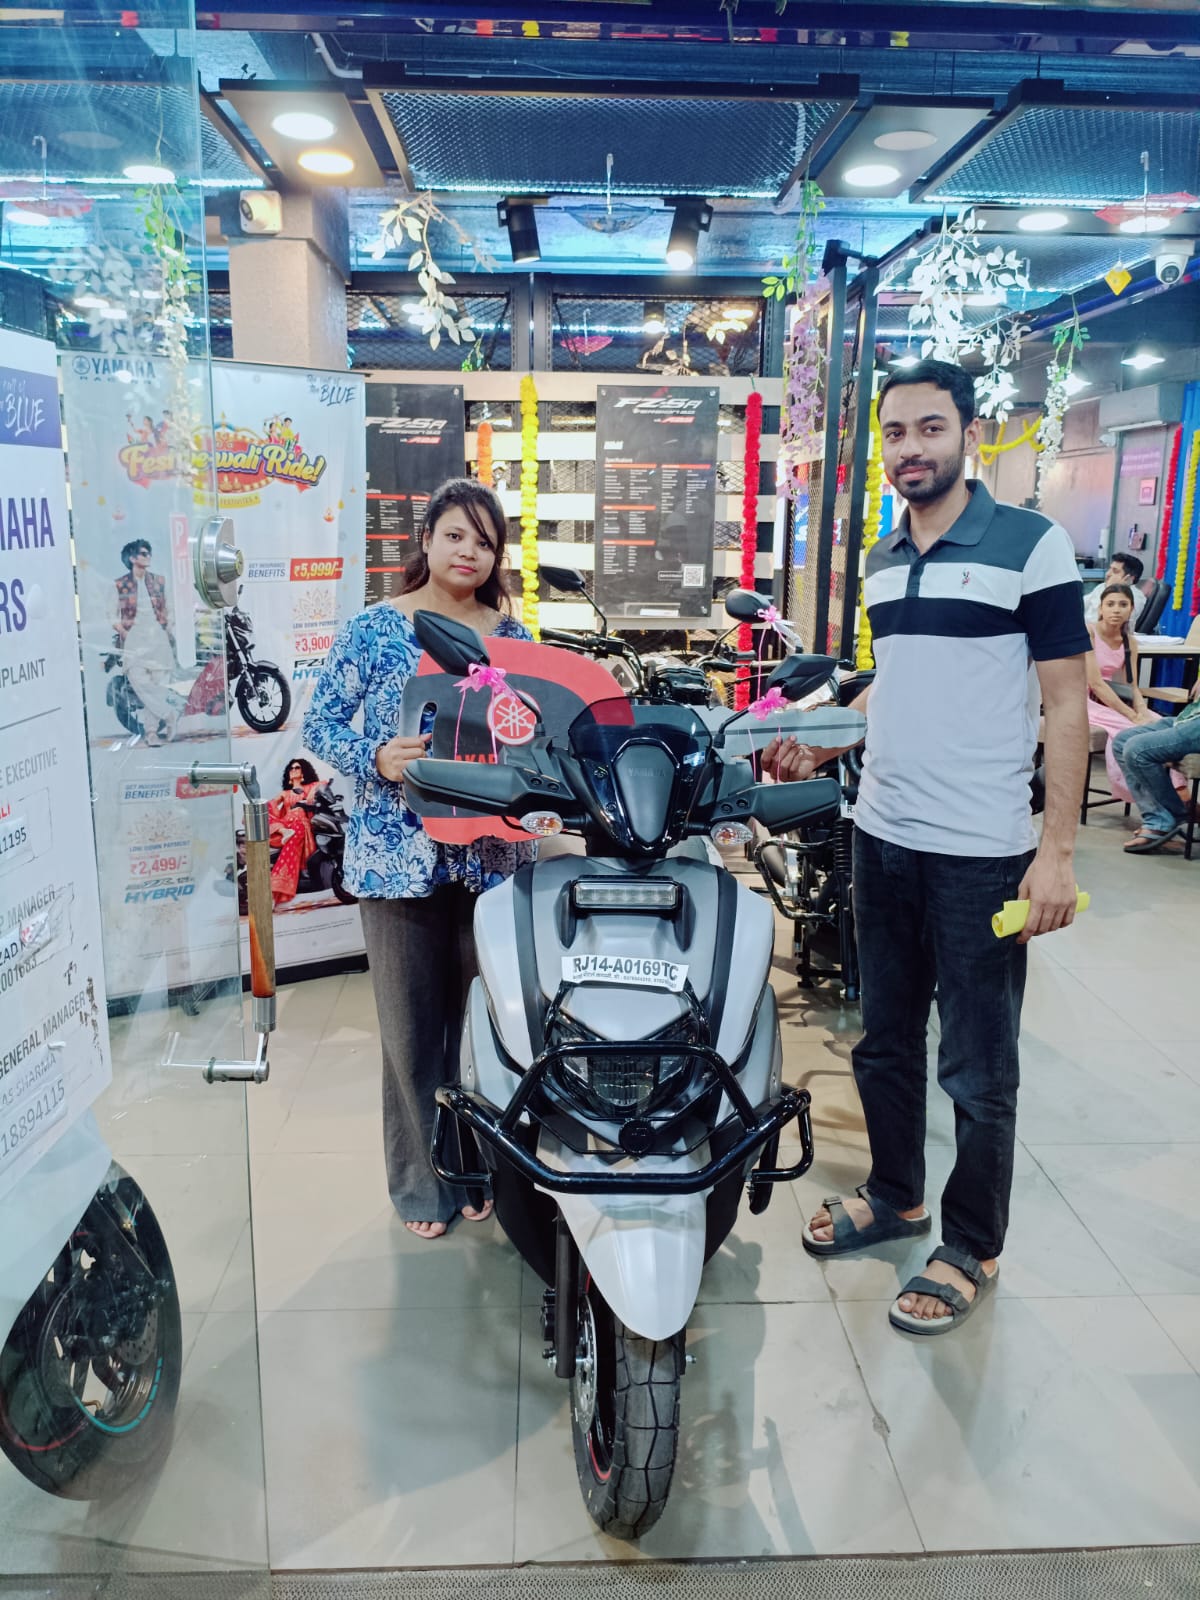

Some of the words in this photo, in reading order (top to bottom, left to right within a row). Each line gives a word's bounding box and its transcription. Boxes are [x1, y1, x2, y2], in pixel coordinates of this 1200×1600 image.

[91, 357, 156, 379] YAMAHA
[320, 384, 356, 406] BLUE
[5, 393, 46, 437] BLUE
[263, 444, 326, 486] Ride!
[0, 497, 55, 550] AHA
[248, 568, 286, 578] BENEFITS
[0, 657, 46, 689] PLAINT
[6, 748, 58, 786] EXECUTIVE
[124, 788, 171, 800] BENEFITS
[8, 883, 56, 930] MANAGER
[124, 884, 196, 904] HYBRID
[573, 956, 679, 981] RJ14-A0169TC
[43, 990, 87, 1041] MANAGER
